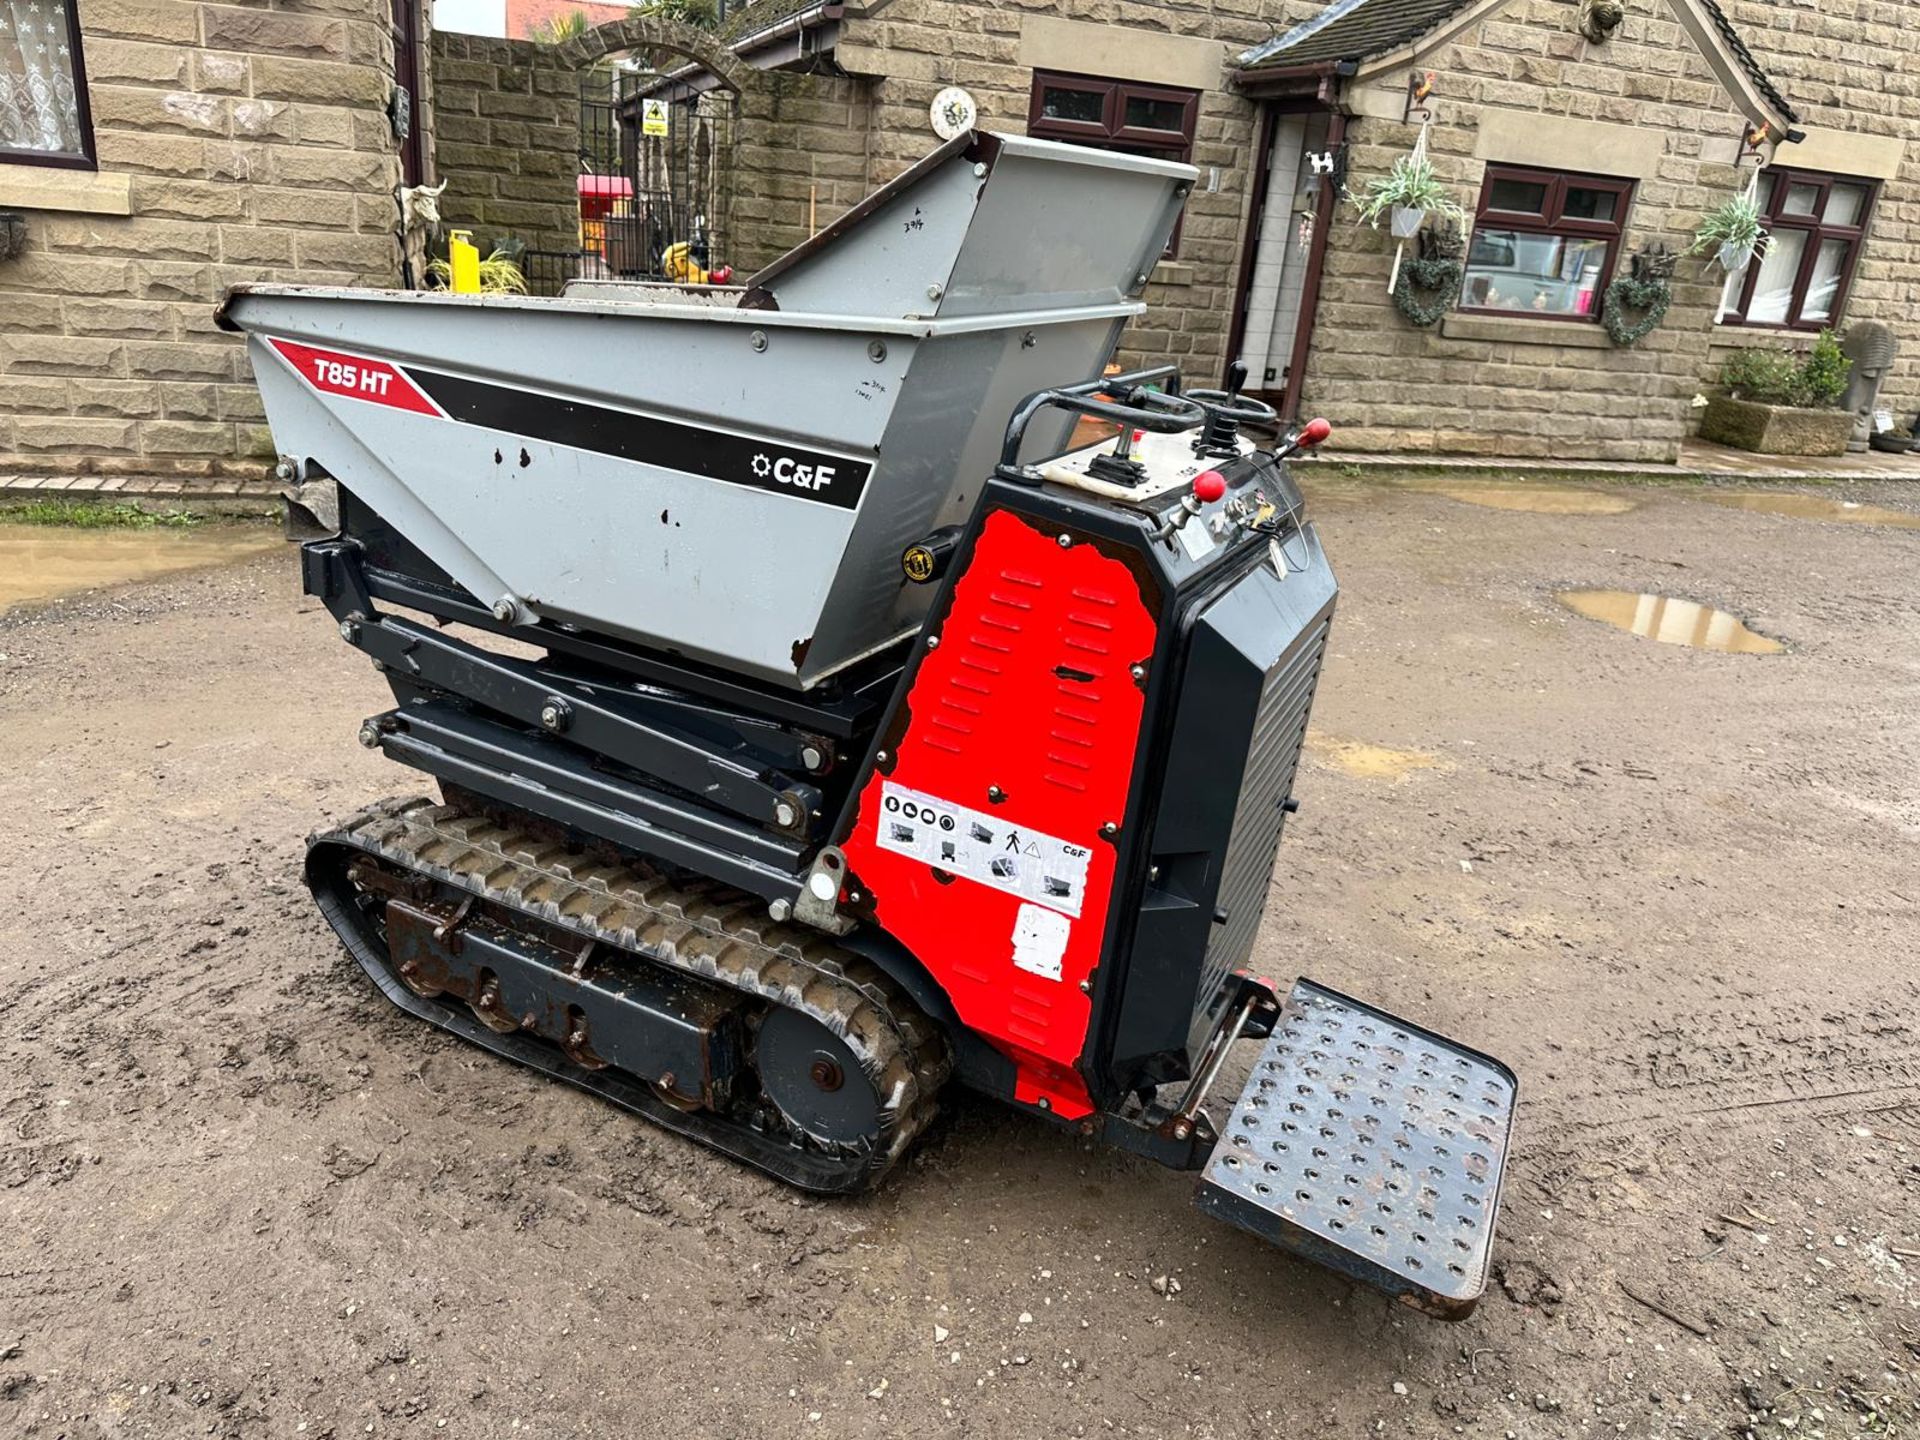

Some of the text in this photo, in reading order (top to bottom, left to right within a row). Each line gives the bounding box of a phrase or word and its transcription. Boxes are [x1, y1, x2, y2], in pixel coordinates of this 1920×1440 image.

[314, 358, 394, 396] T85 HT
[773, 457, 836, 491] C&F
[1062, 845, 1087, 858] C&F
